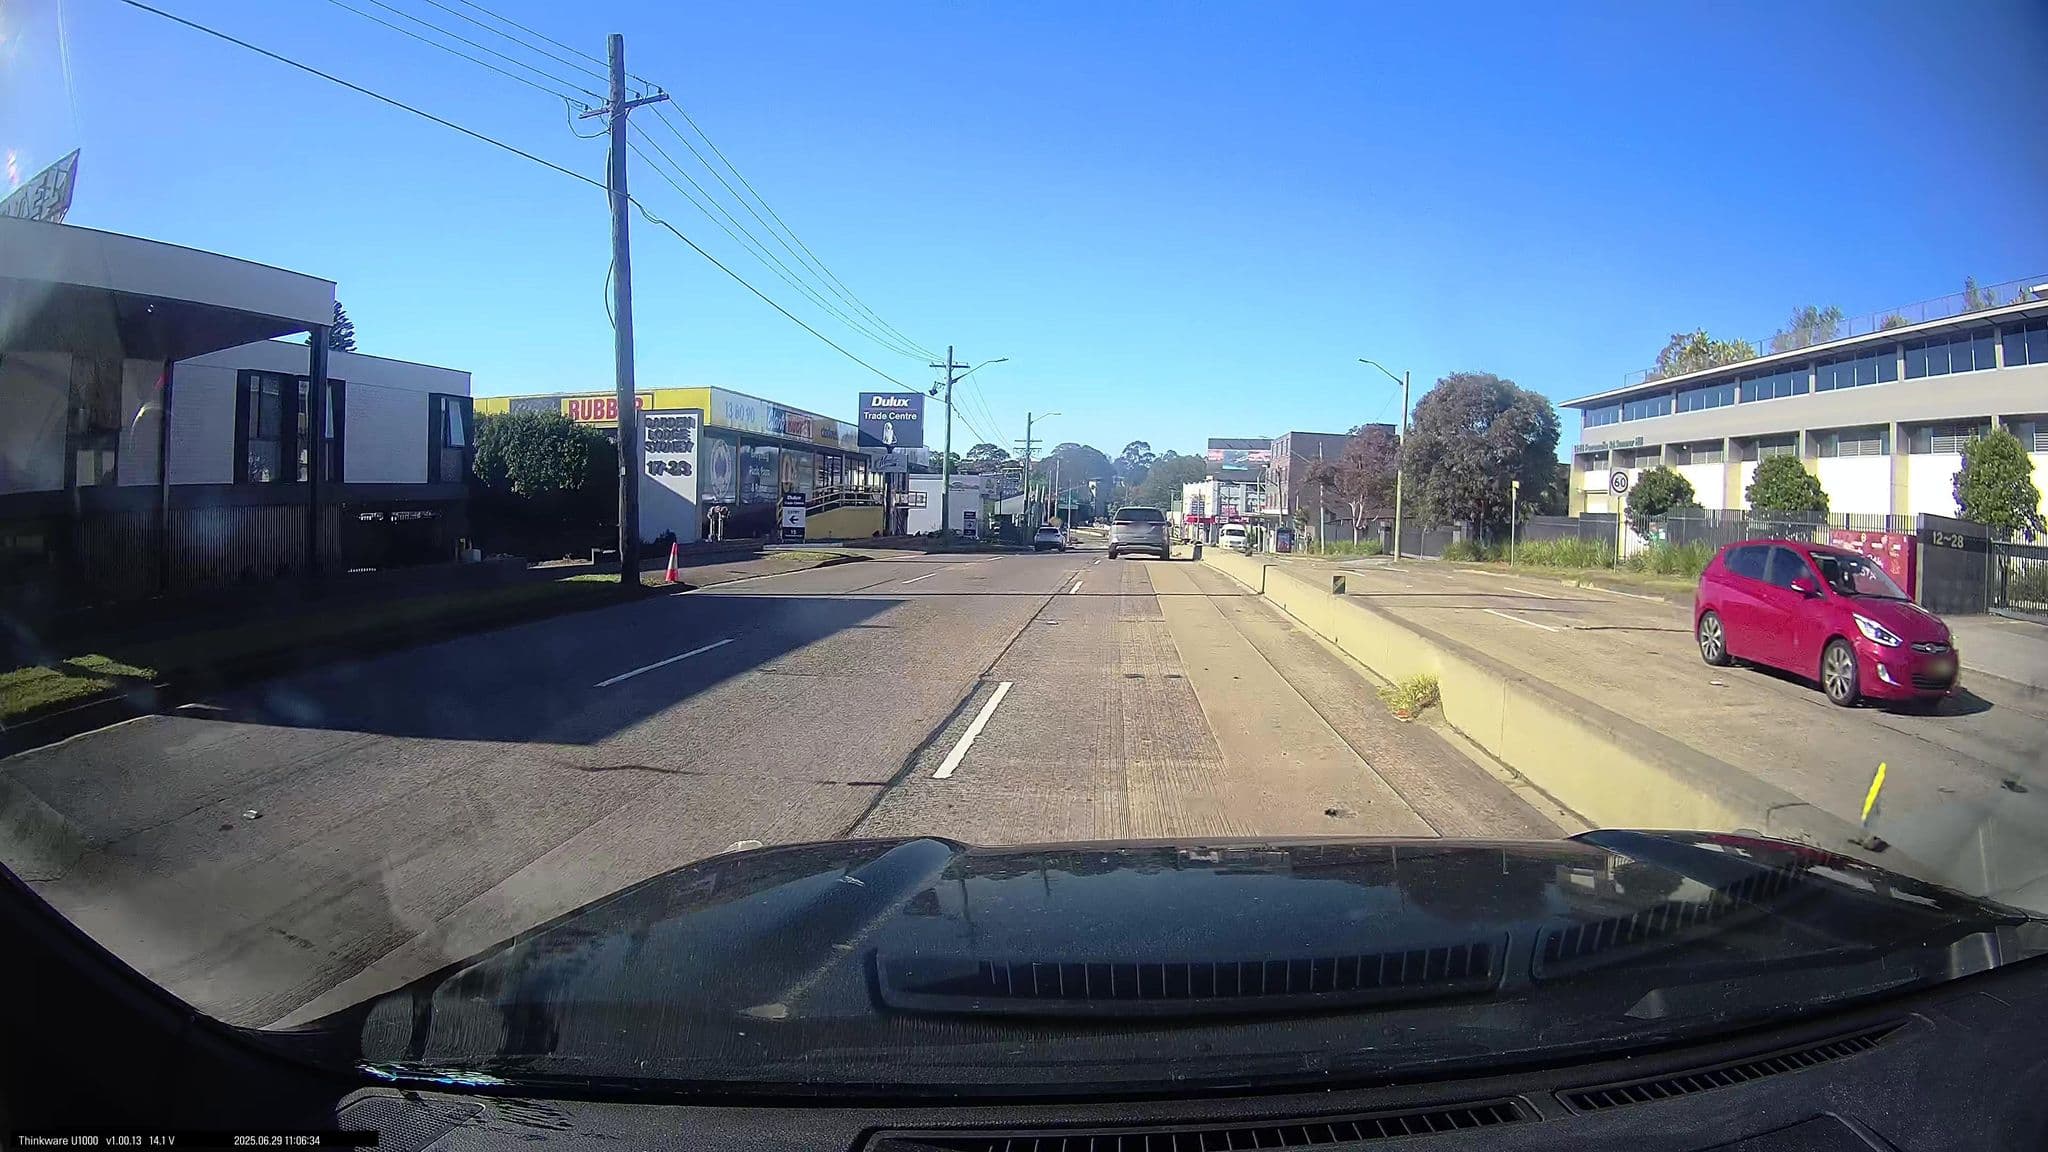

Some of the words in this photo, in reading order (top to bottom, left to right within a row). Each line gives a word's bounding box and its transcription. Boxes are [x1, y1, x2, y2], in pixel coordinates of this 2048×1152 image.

[871, 396, 908, 407] Dulux
[569, 397, 643, 420] RUBB
[864, 412, 887, 420] Trade
[889, 412, 917, 420] Centre
[647, 461, 692, 476] 17-23
[1614, 478, 1626, 487] 60
